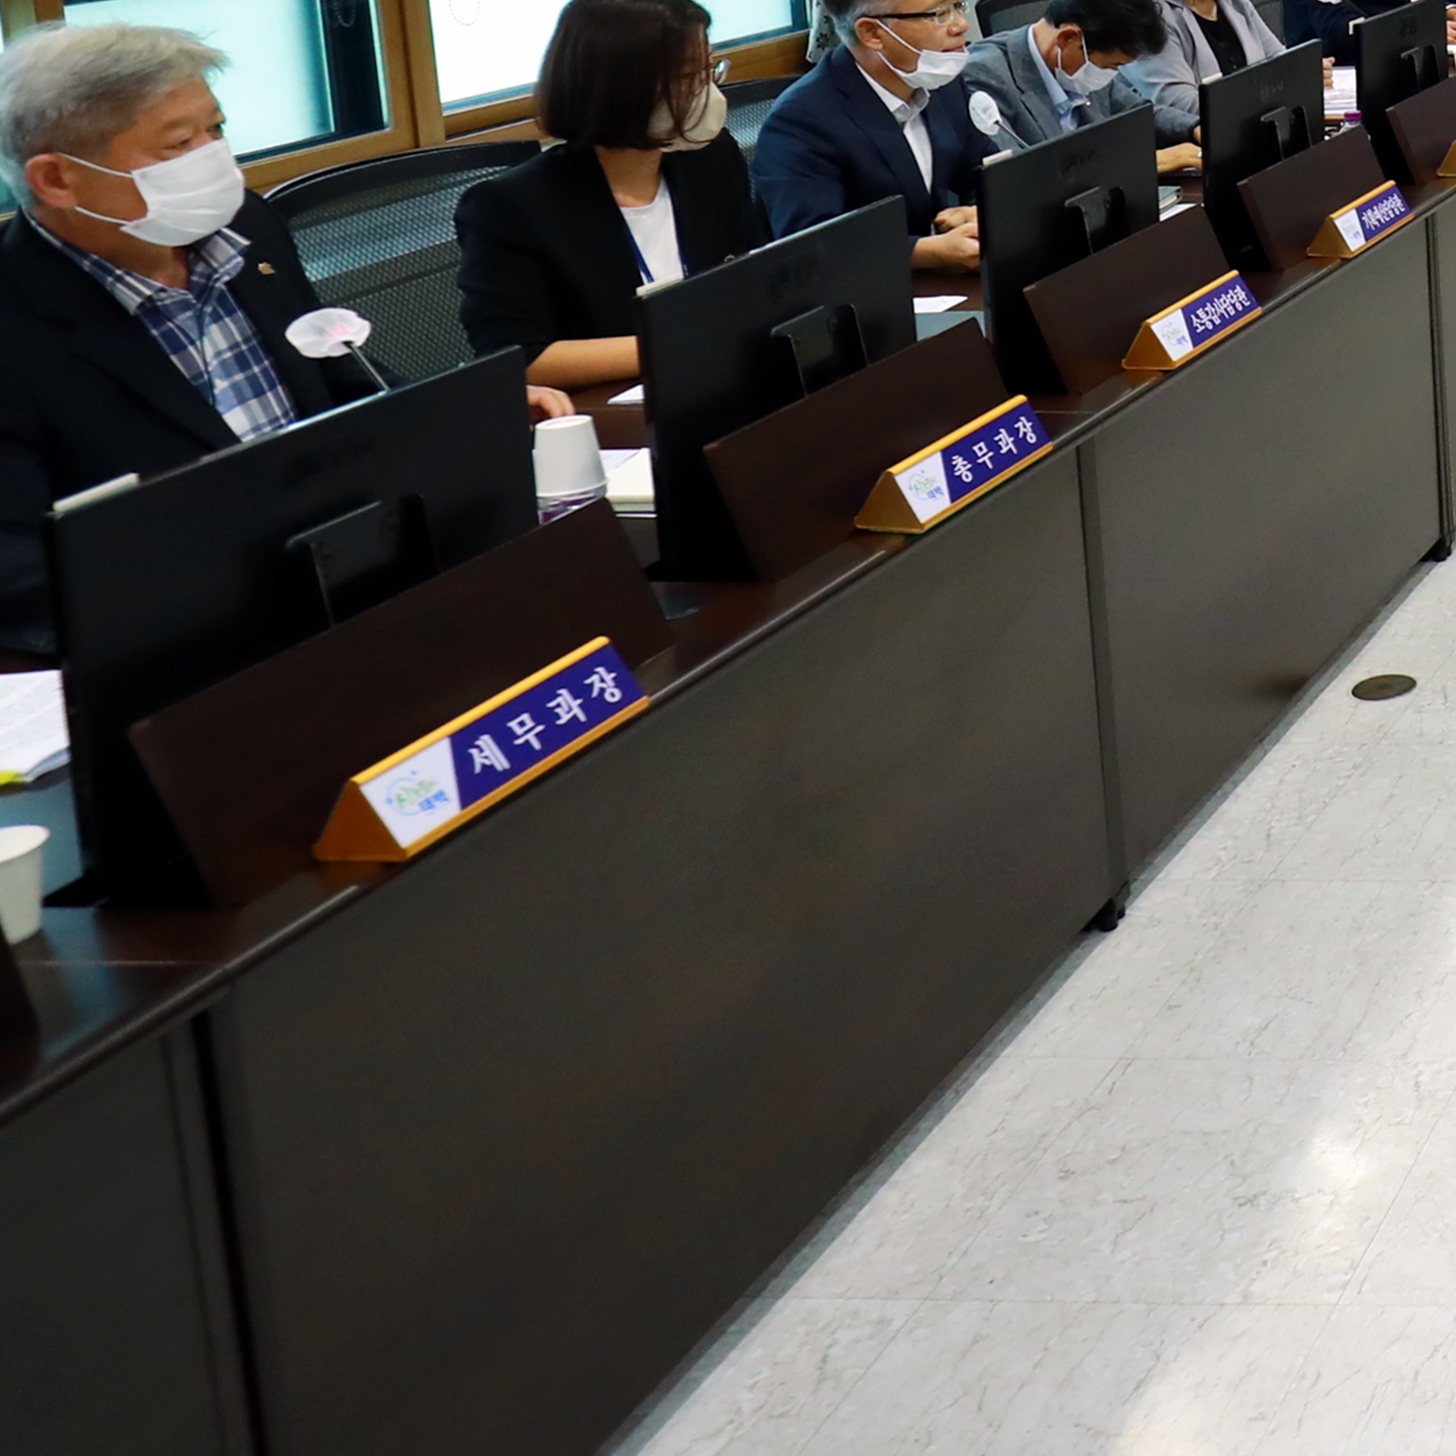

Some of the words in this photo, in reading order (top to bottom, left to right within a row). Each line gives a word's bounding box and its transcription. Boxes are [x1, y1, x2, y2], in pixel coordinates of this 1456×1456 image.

[1190, 285, 1251, 334] 소통감사담당관
[951, 416, 1037, 483] 총무과장
[468, 666, 623, 774] 세무과장
